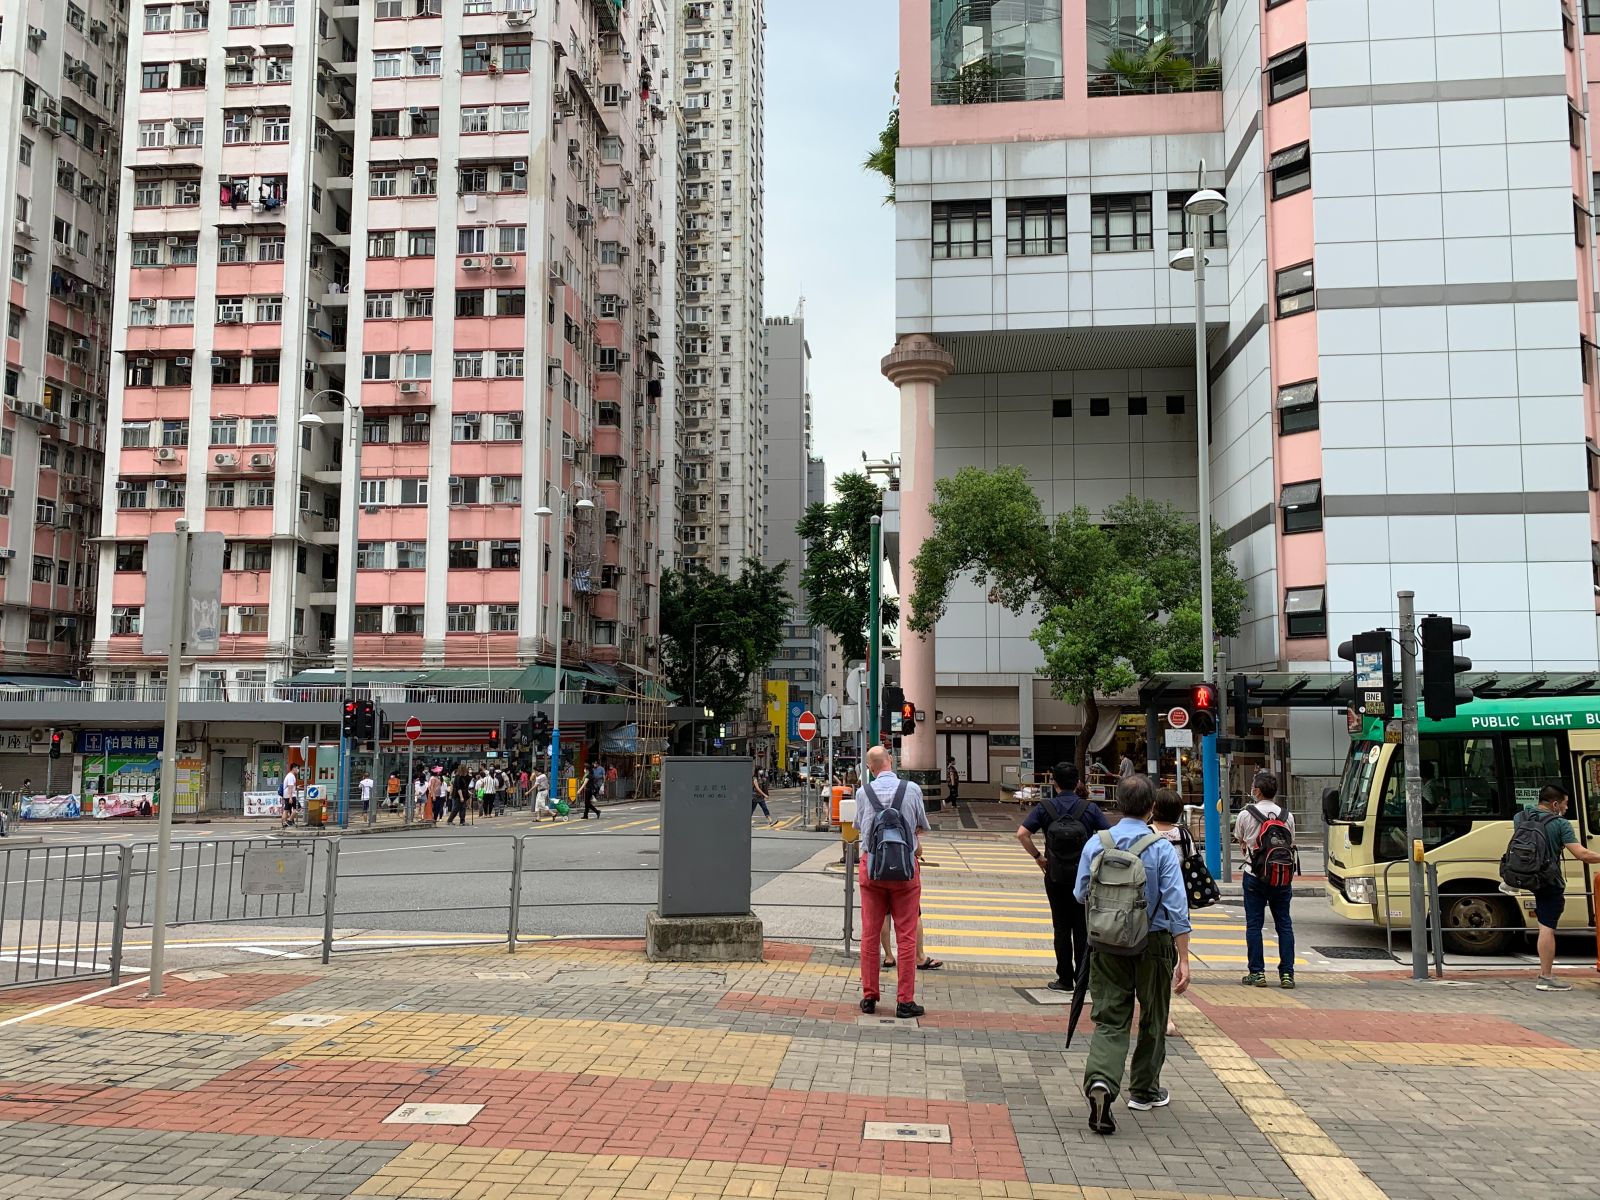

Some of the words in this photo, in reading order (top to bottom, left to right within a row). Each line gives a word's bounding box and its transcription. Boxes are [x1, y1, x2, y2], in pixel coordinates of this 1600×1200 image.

[1366, 693, 1380, 701] BNE
[1471, 715, 1520, 728] PUBLIC
[1531, 713, 1573, 726] LIGHT
[319, 767, 334, 779] Hi
